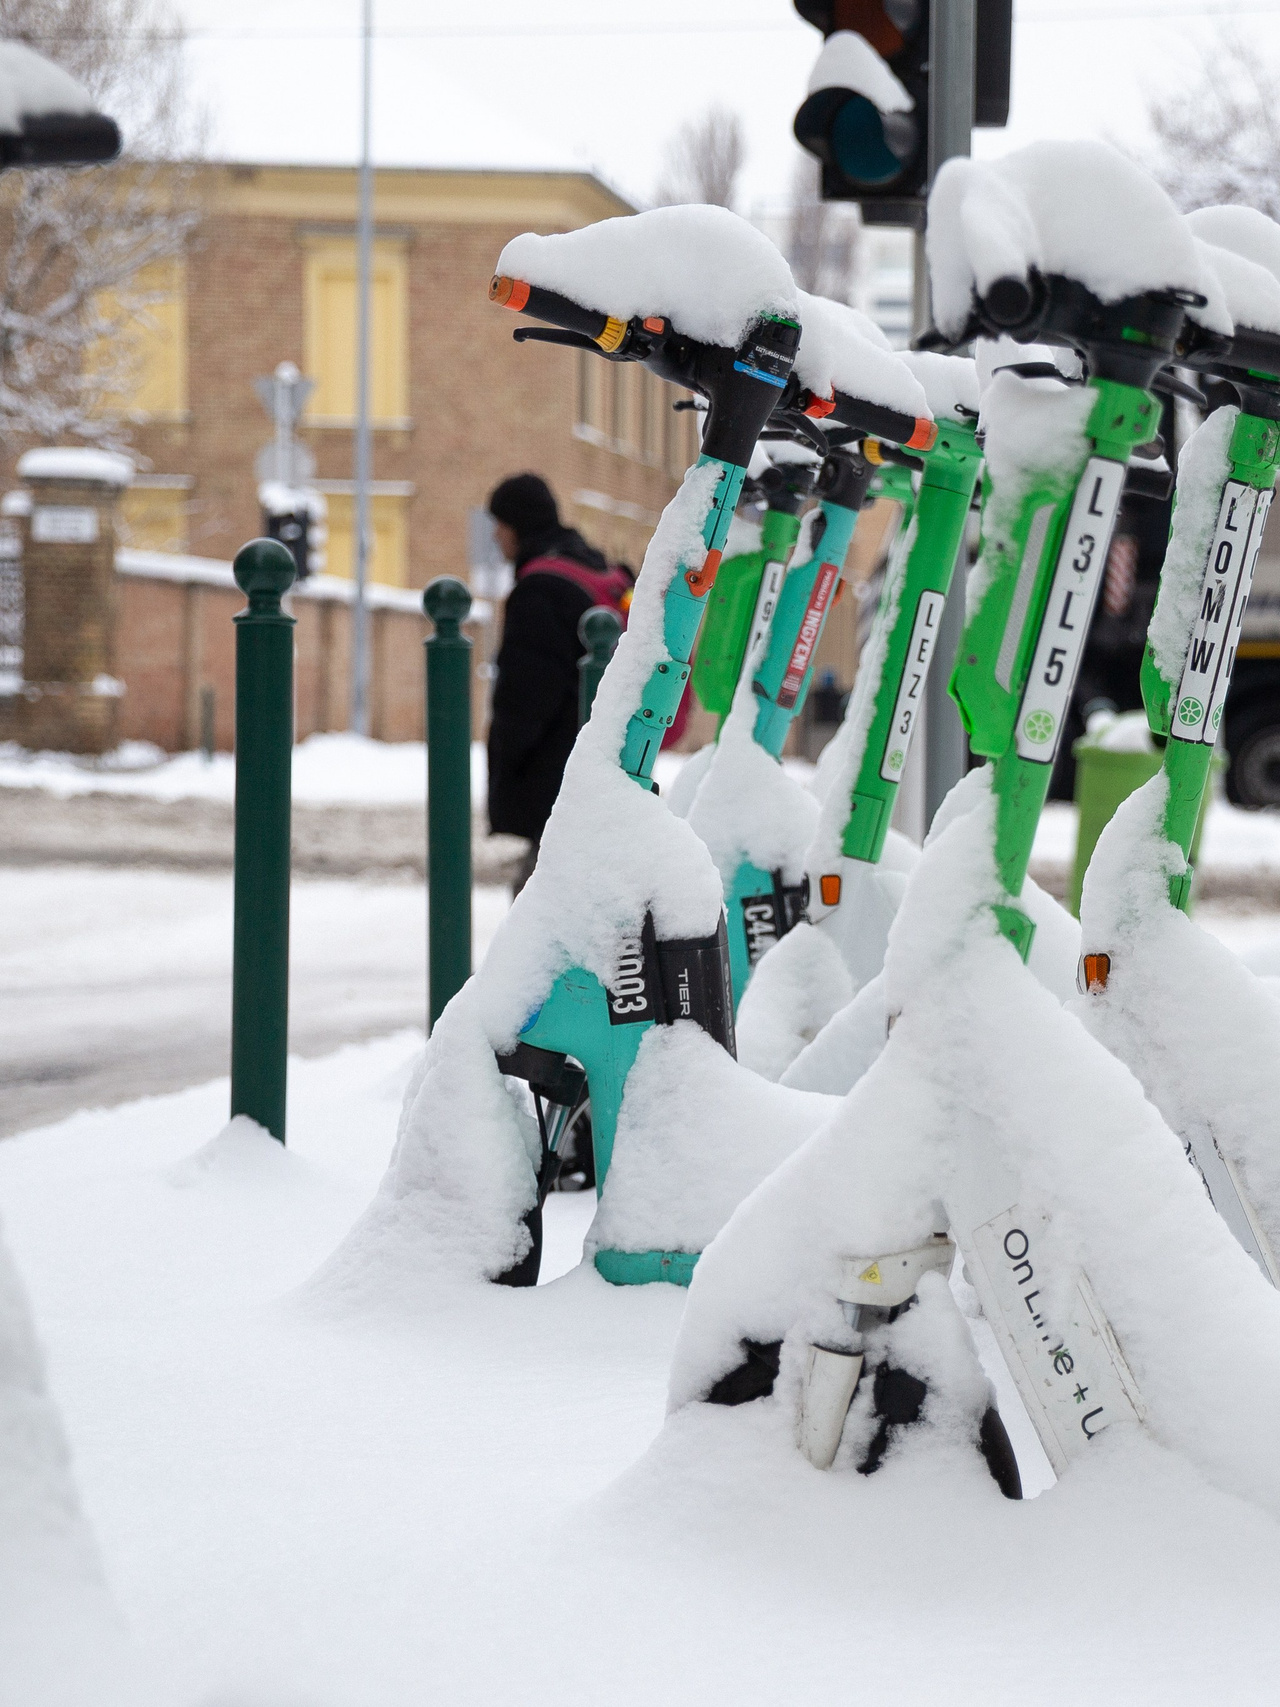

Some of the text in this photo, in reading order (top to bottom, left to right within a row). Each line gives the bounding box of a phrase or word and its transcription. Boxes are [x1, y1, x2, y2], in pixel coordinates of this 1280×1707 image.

[1043, 477, 1104, 687] L3L5
[1190, 497, 1238, 674] LOMW
[790, 609, 822, 671] INGYEN!
[900, 603, 934, 735] LEZ3
[678, 968, 691, 1016] TIER
[1003, 1228, 1034, 1286] On
